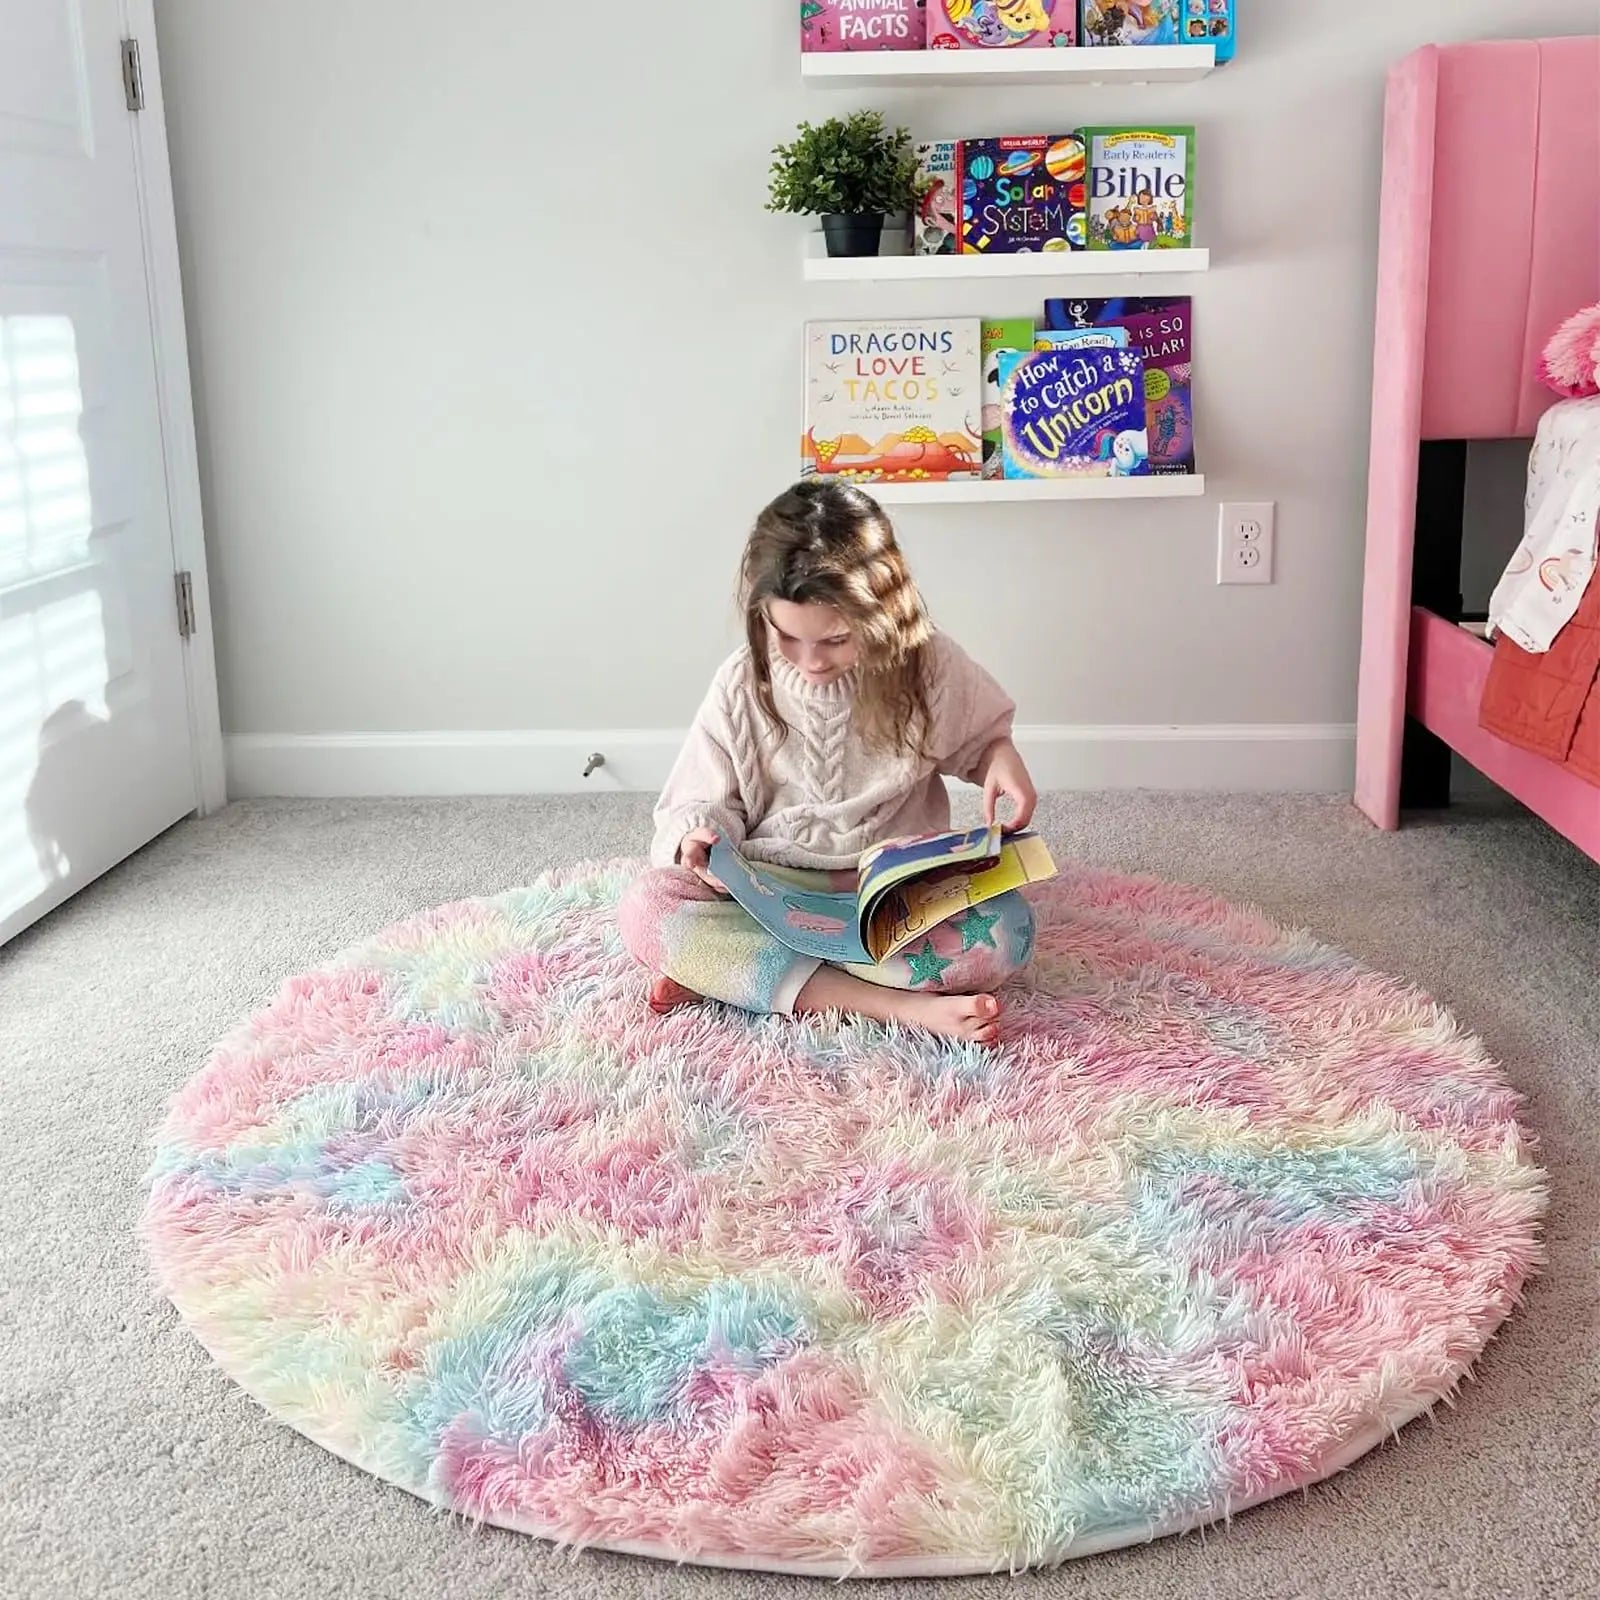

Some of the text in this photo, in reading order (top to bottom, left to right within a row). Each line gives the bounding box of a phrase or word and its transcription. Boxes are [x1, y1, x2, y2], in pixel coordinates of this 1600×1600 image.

[839, 14, 909, 41] FACTS
[931, 153, 950, 162] OLD
[1103, 150, 1176, 161] Early Reader's
[1090, 166, 1186, 198] Bible
[1139, 327, 1154, 339] IS
[1160, 316, 1183, 334] SO
[831, 330, 953, 355] DRAGONS
[1081, 336, 1109, 347] Read!
[856, 356, 926, 376] LOVE
[1017, 355, 1059, 390] How
[843, 378, 939, 402] TACOS
[1019, 354, 1116, 414] to Catch a
[1021, 378, 1133, 459] Unicorn
